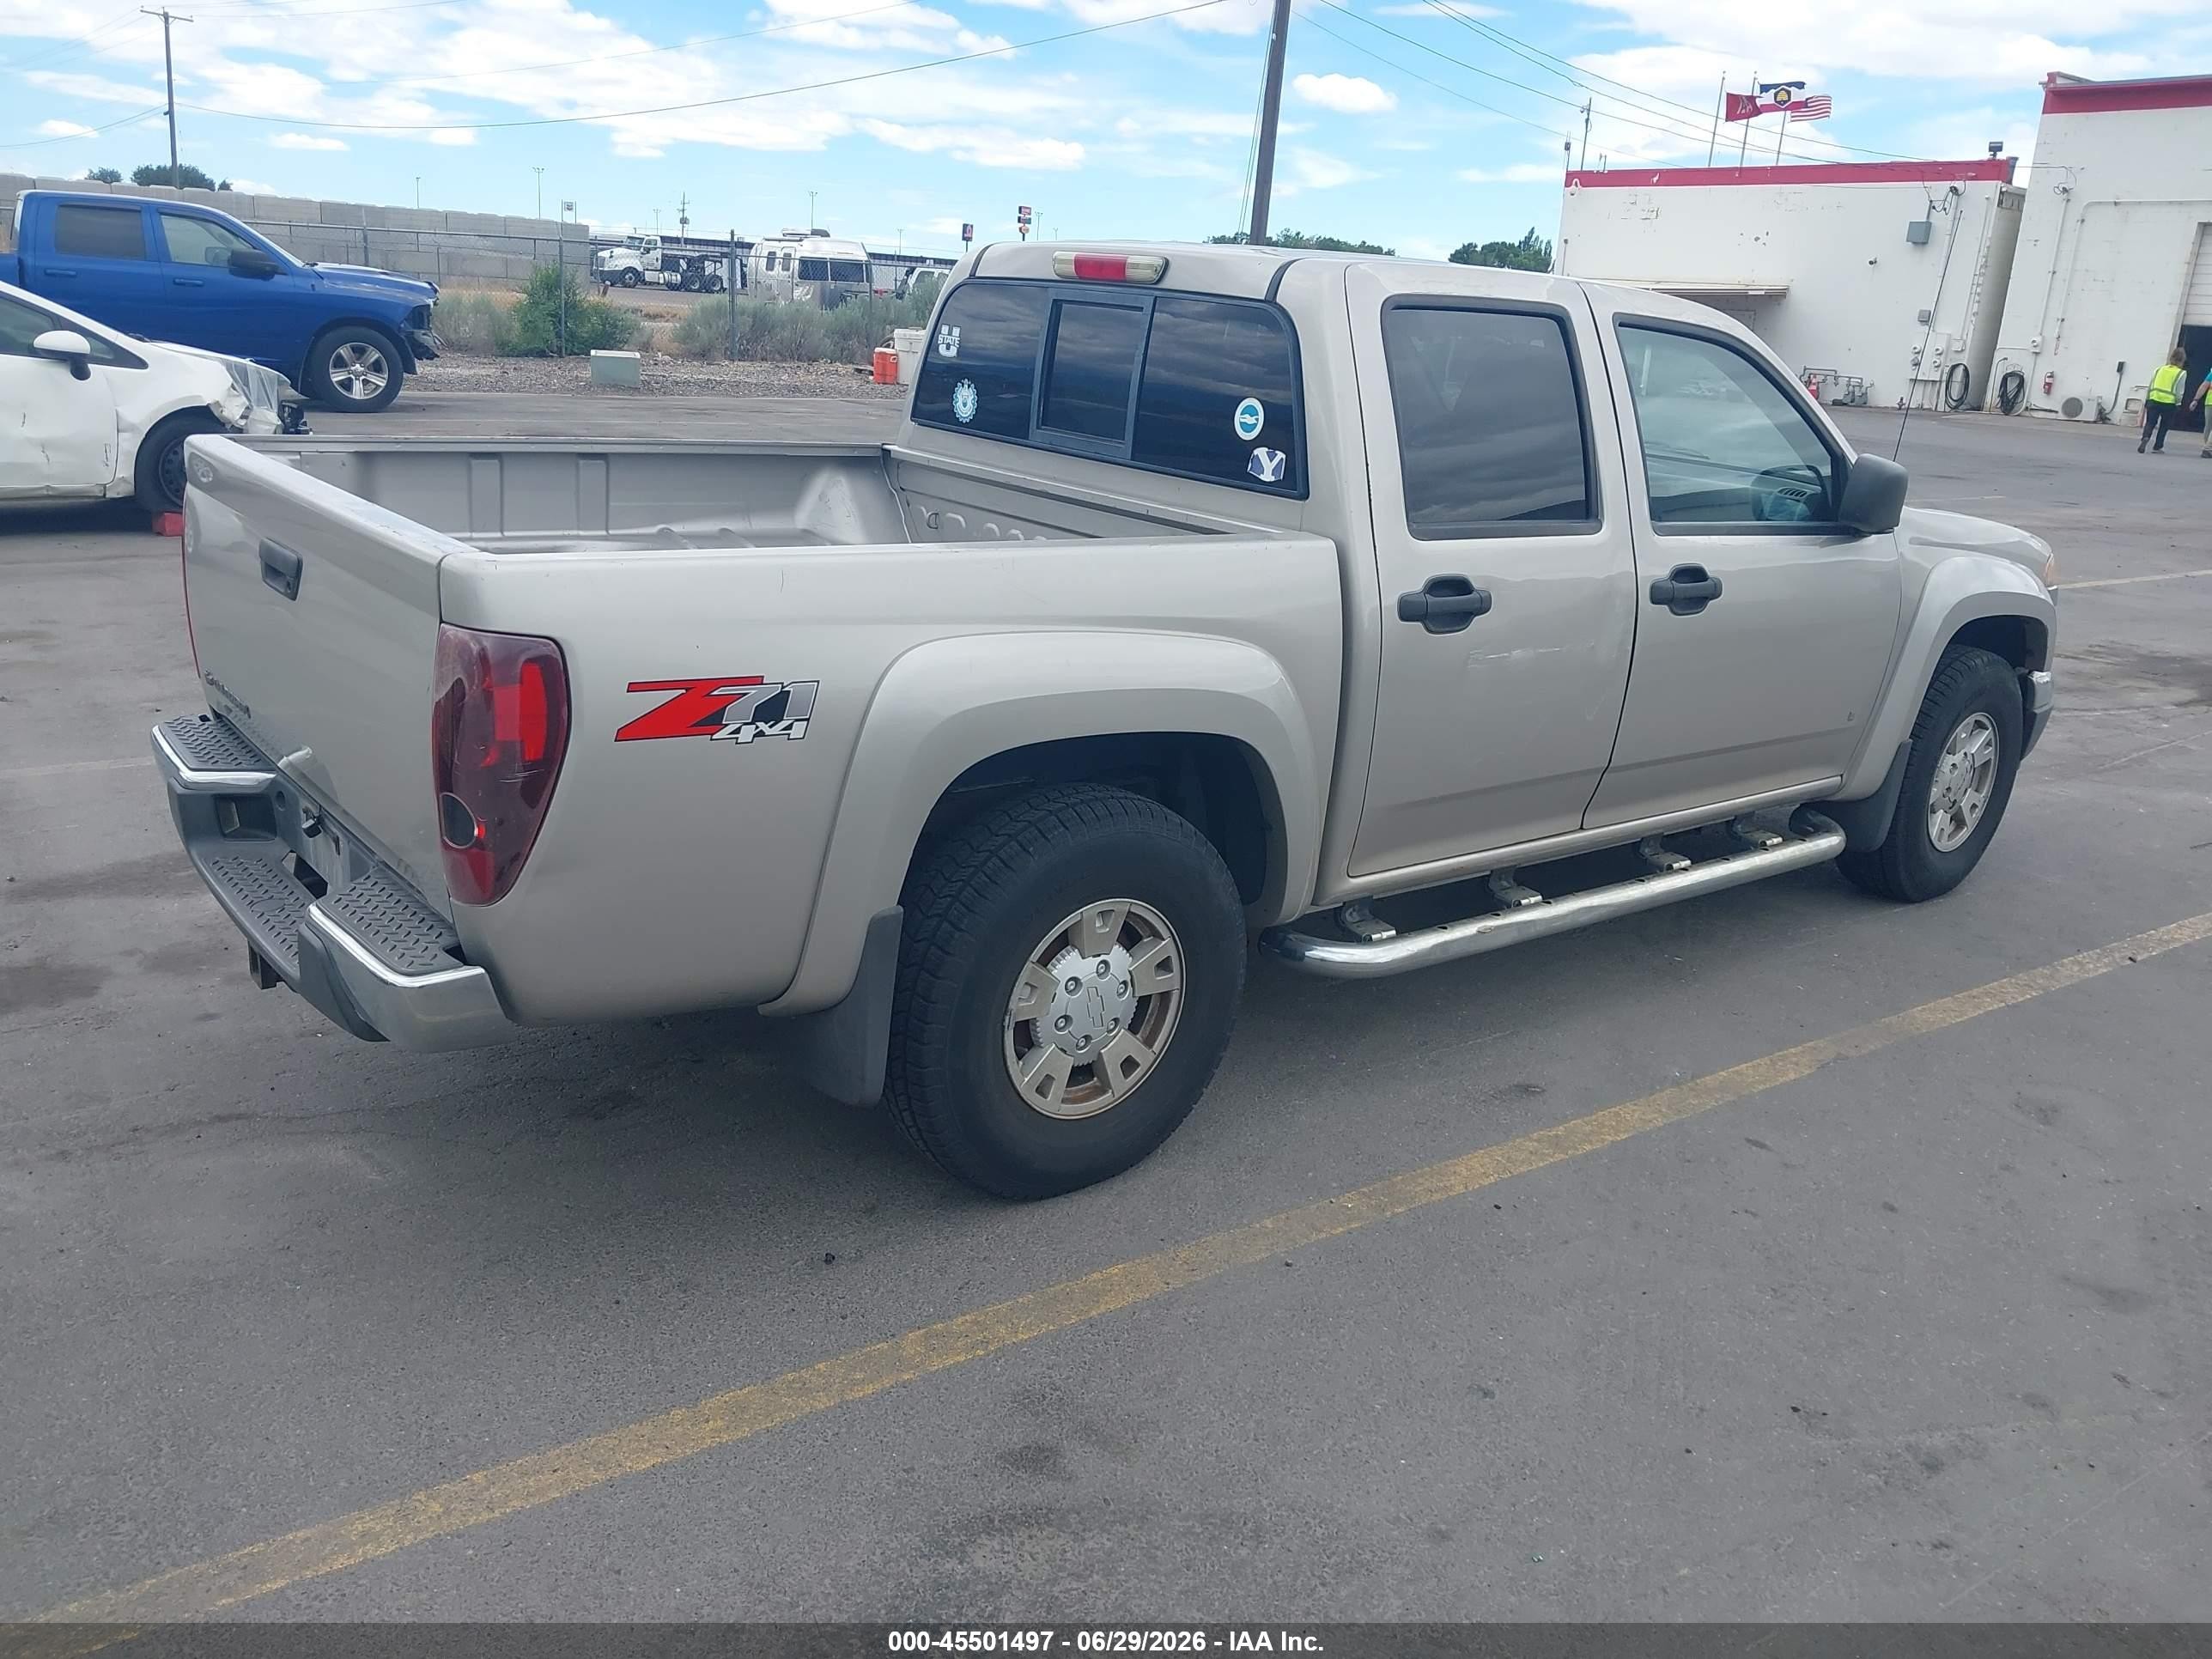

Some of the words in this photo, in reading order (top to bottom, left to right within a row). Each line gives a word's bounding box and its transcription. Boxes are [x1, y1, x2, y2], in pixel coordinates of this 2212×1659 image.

[938, 333, 961, 348] STATE
[1253, 447, 1286, 482] Y
[614, 675, 820, 743] Z71
